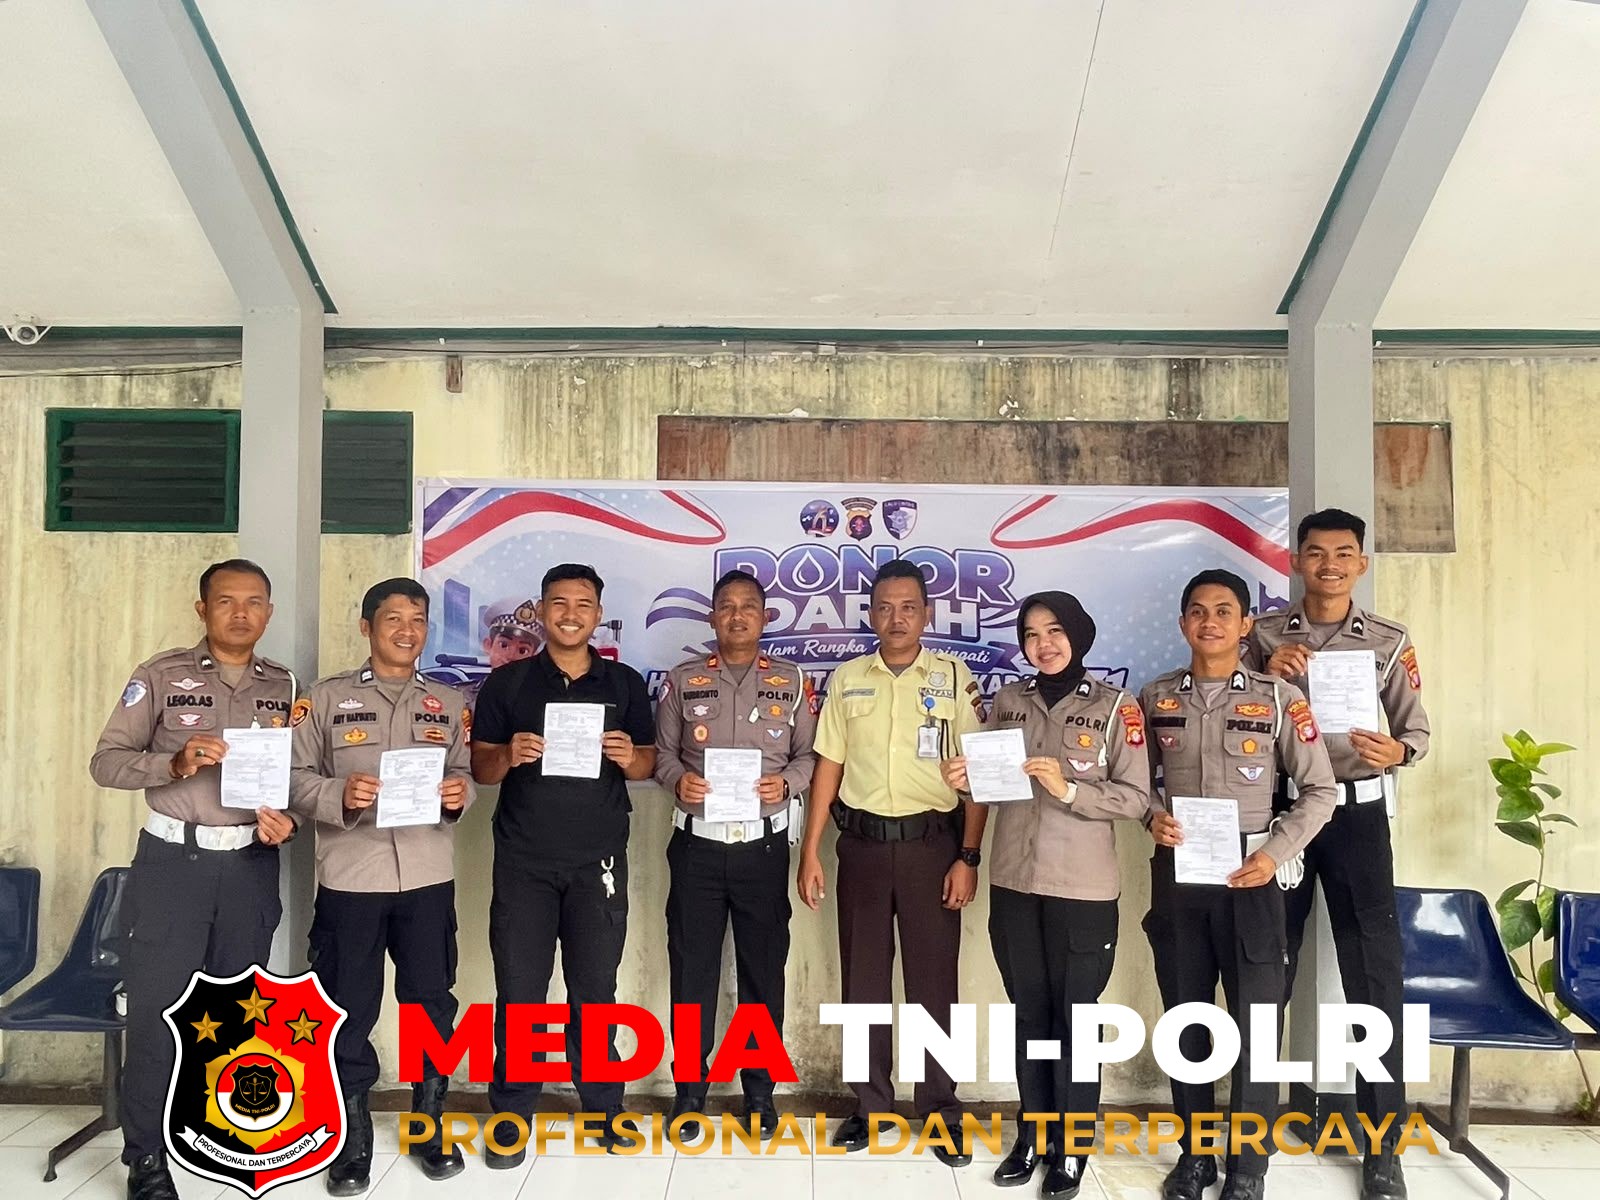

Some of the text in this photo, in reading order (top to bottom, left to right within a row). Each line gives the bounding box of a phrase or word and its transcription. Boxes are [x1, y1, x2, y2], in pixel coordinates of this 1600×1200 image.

[712, 545, 1017, 605] DONOR
[763, 594, 978, 638] DARH
[762, 642, 798, 656] lam
[803, 638, 867, 658] Rangka
[758, 690, 794, 702] POLRI
[415, 713, 449, 725] POLRI
[1065, 715, 1106, 732] POLRI
